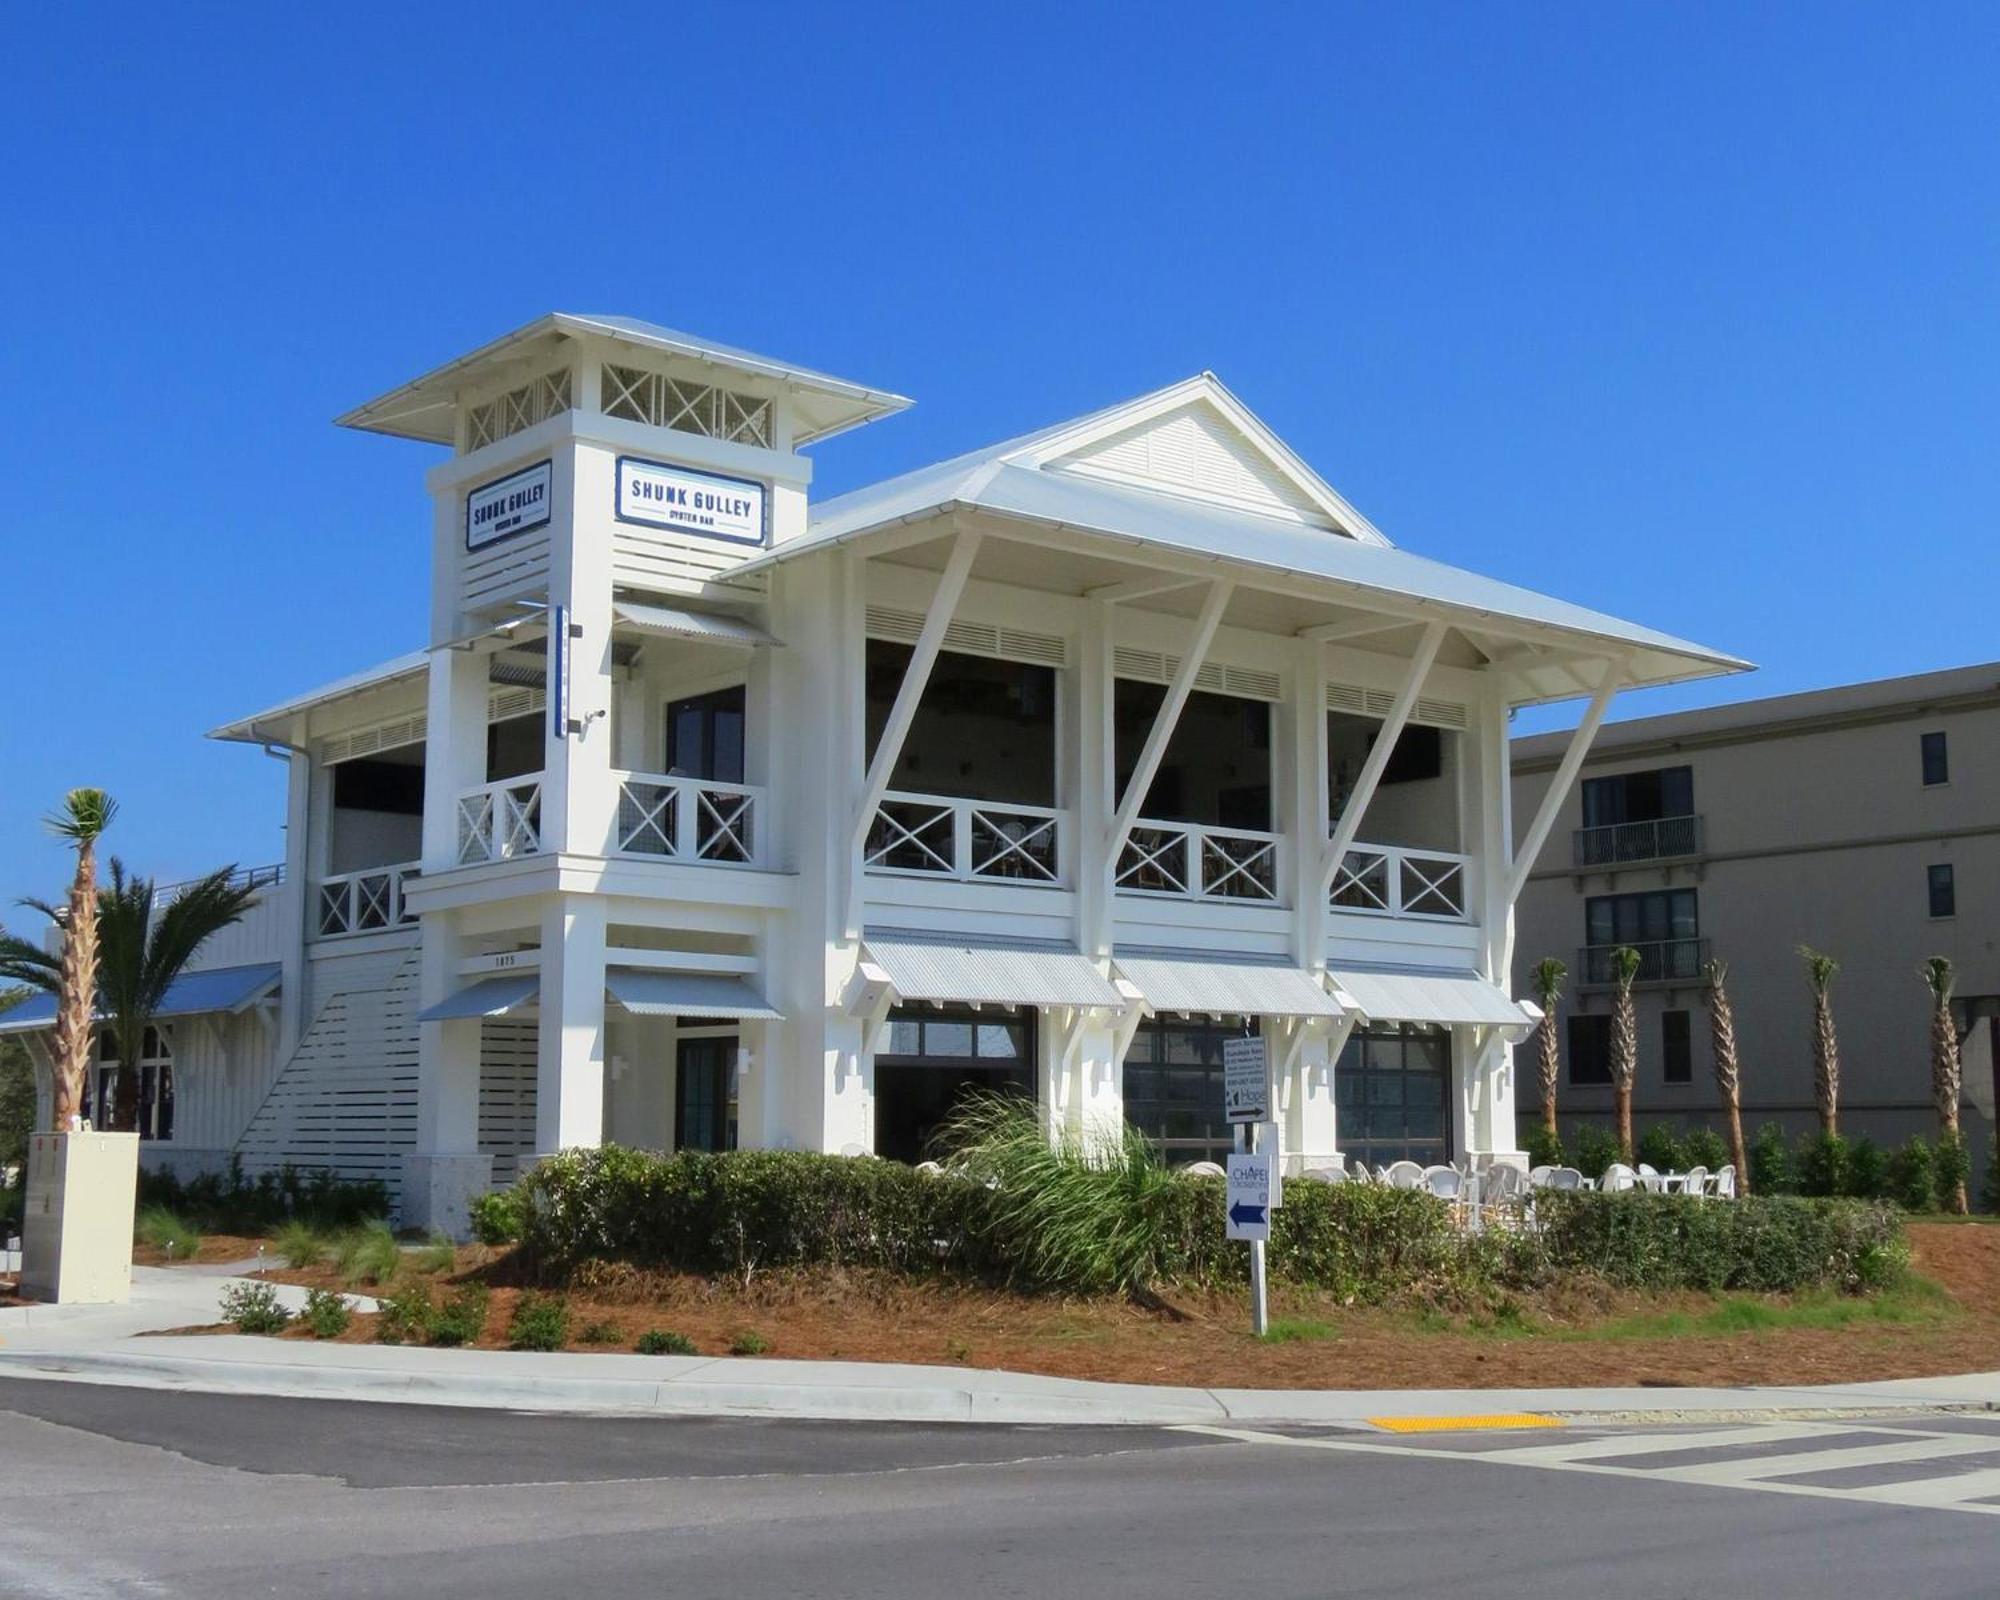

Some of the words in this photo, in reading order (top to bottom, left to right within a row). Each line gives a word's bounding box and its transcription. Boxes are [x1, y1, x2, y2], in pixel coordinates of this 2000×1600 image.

[508, 483, 545, 512] GULLEY
[632, 479, 687, 506] SHUNK
[694, 491, 752, 518] GULLEY
[669, 509, 697, 523] OYSTER
[700, 515, 714, 526] BAR
